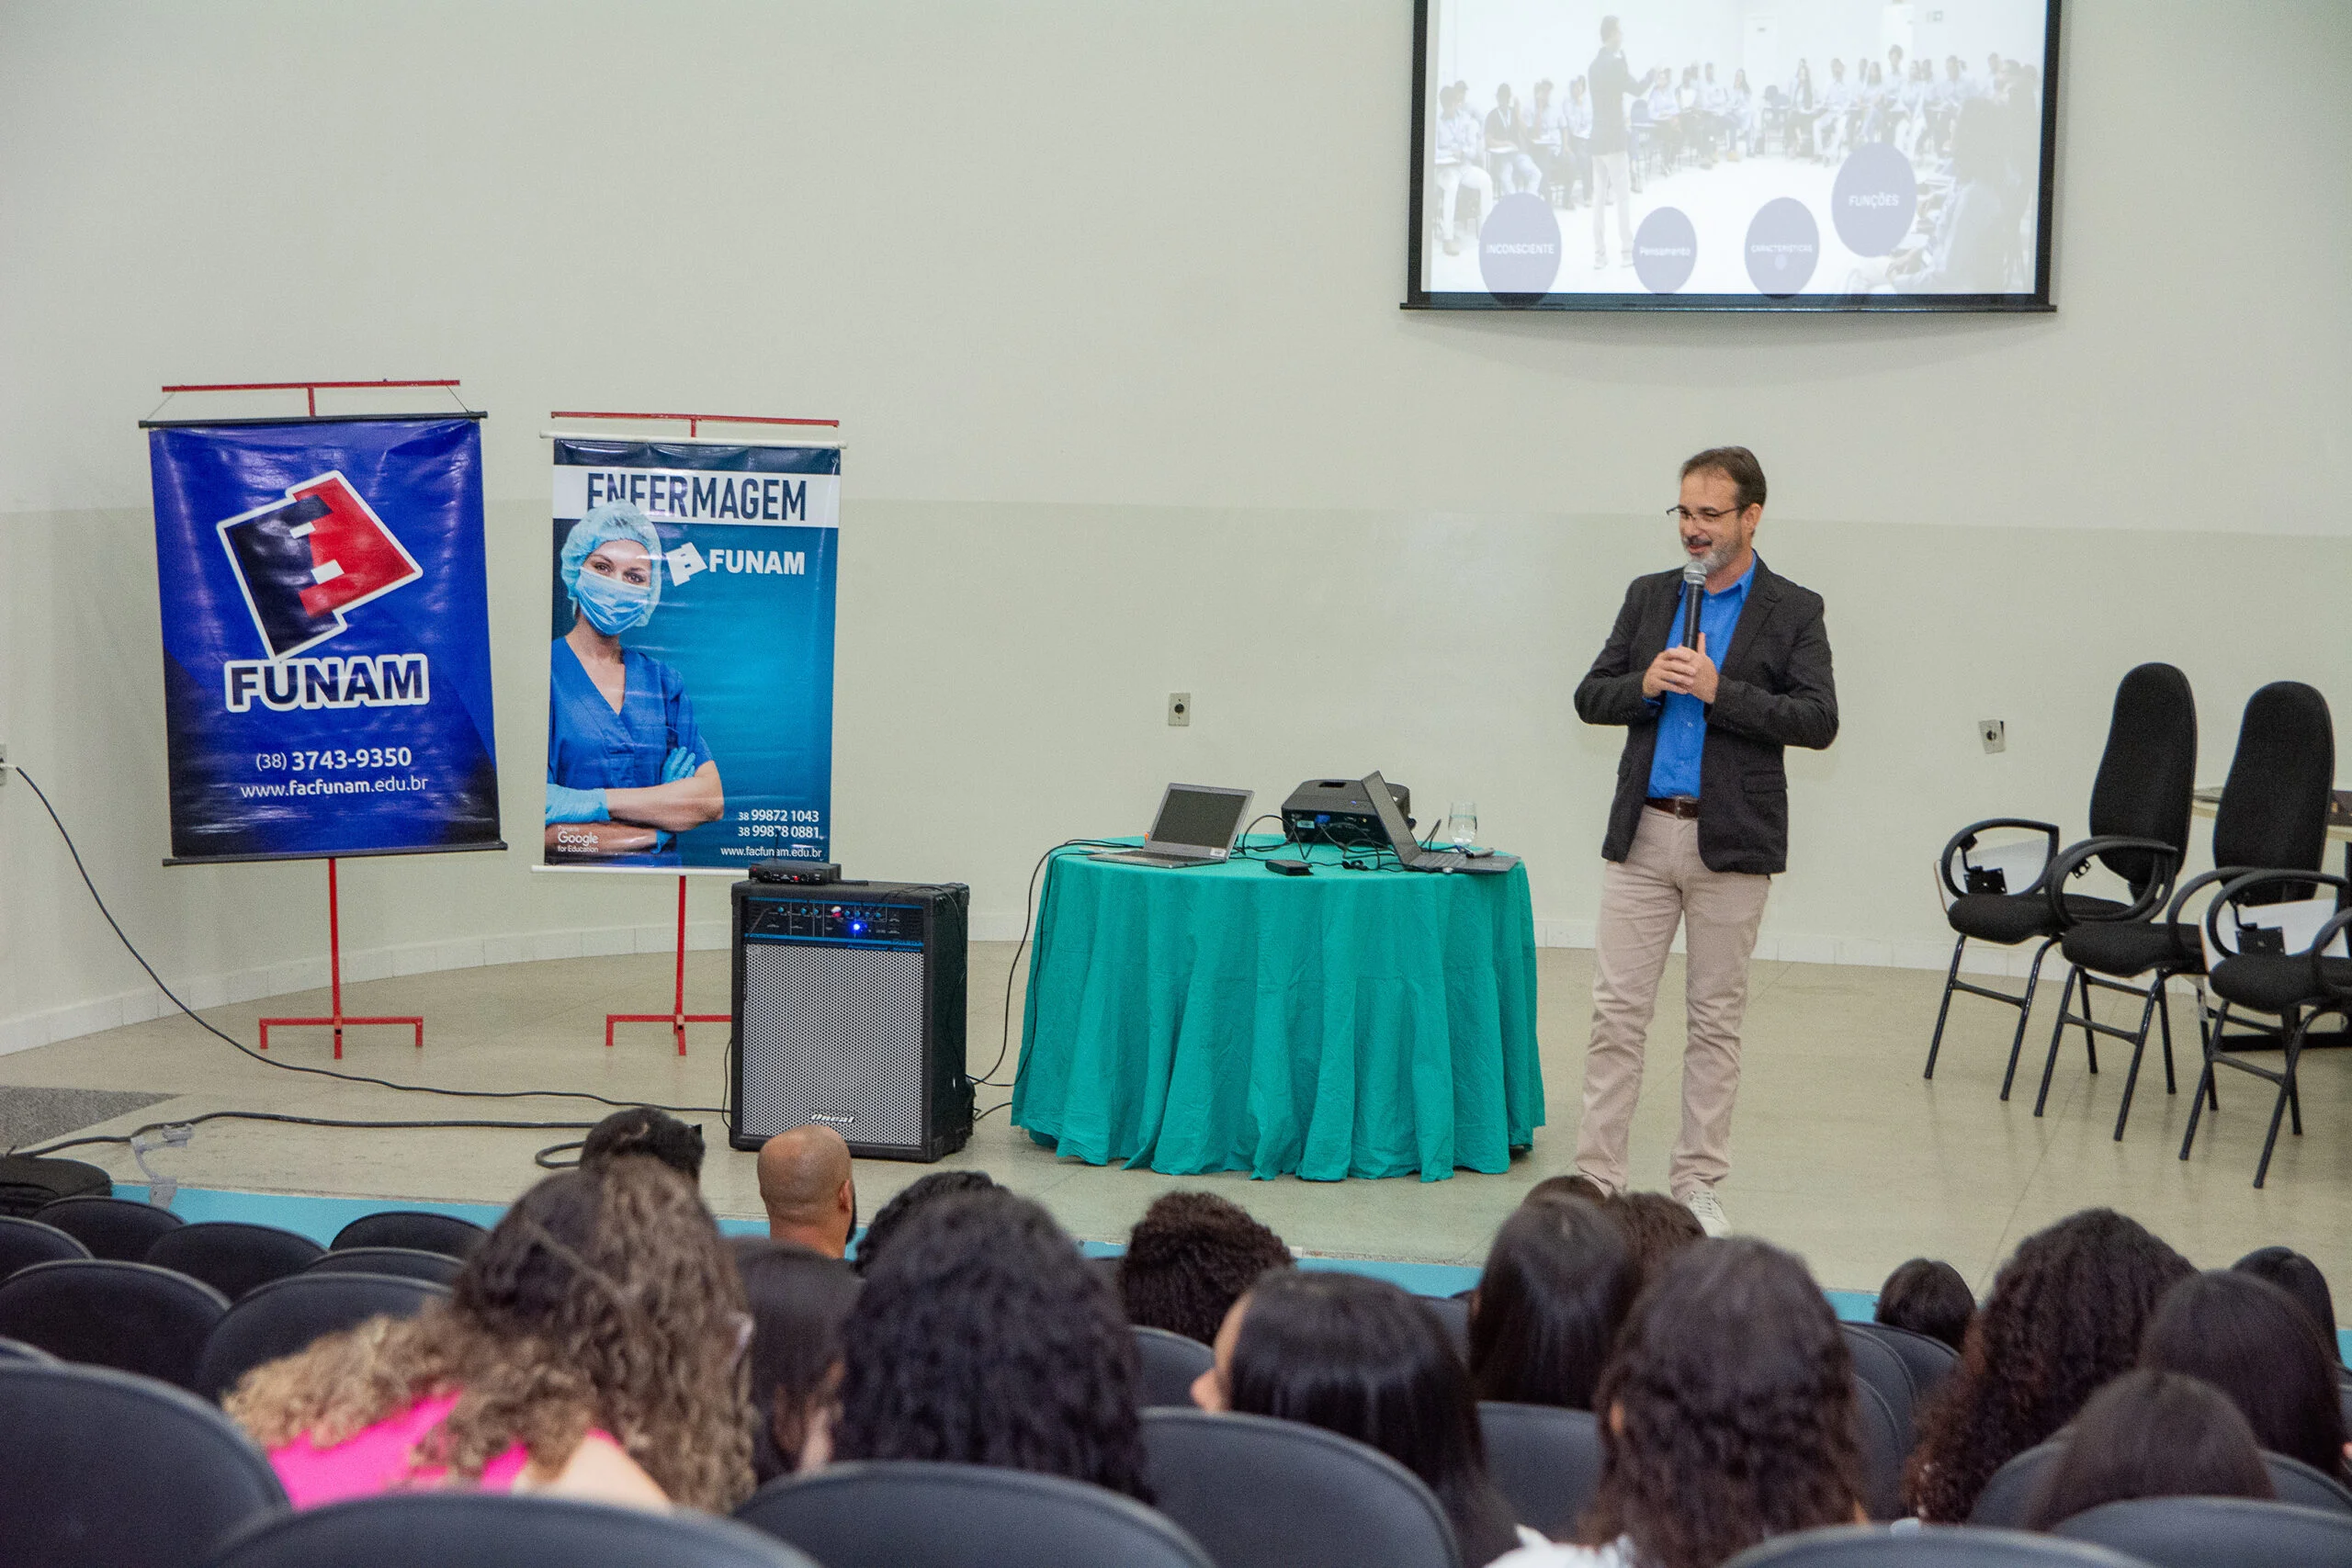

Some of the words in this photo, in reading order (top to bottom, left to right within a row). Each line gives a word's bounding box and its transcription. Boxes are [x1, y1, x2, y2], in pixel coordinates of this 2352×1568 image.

[1849, 192, 1900, 209] FUNÇÕES
[1487, 243, 1555, 255] INCONSCIENTE
[587, 472, 807, 521] ENFERMAGEM
[709, 549, 805, 575] FUNAM
[226, 654, 429, 712] FUNAM
[255, 752, 288, 772] (38)
[291, 747, 412, 772] 3743-9350
[241, 775, 428, 798] www.facfunam.edu.br
[738, 812, 750, 821] 38
[751, 809, 788, 822] 99872
[791, 810, 820, 822] 1043
[558, 830, 599, 846] Google
[738, 827, 750, 837] 38
[791, 826, 820, 839] 0881
[568, 845, 599, 853] Education
